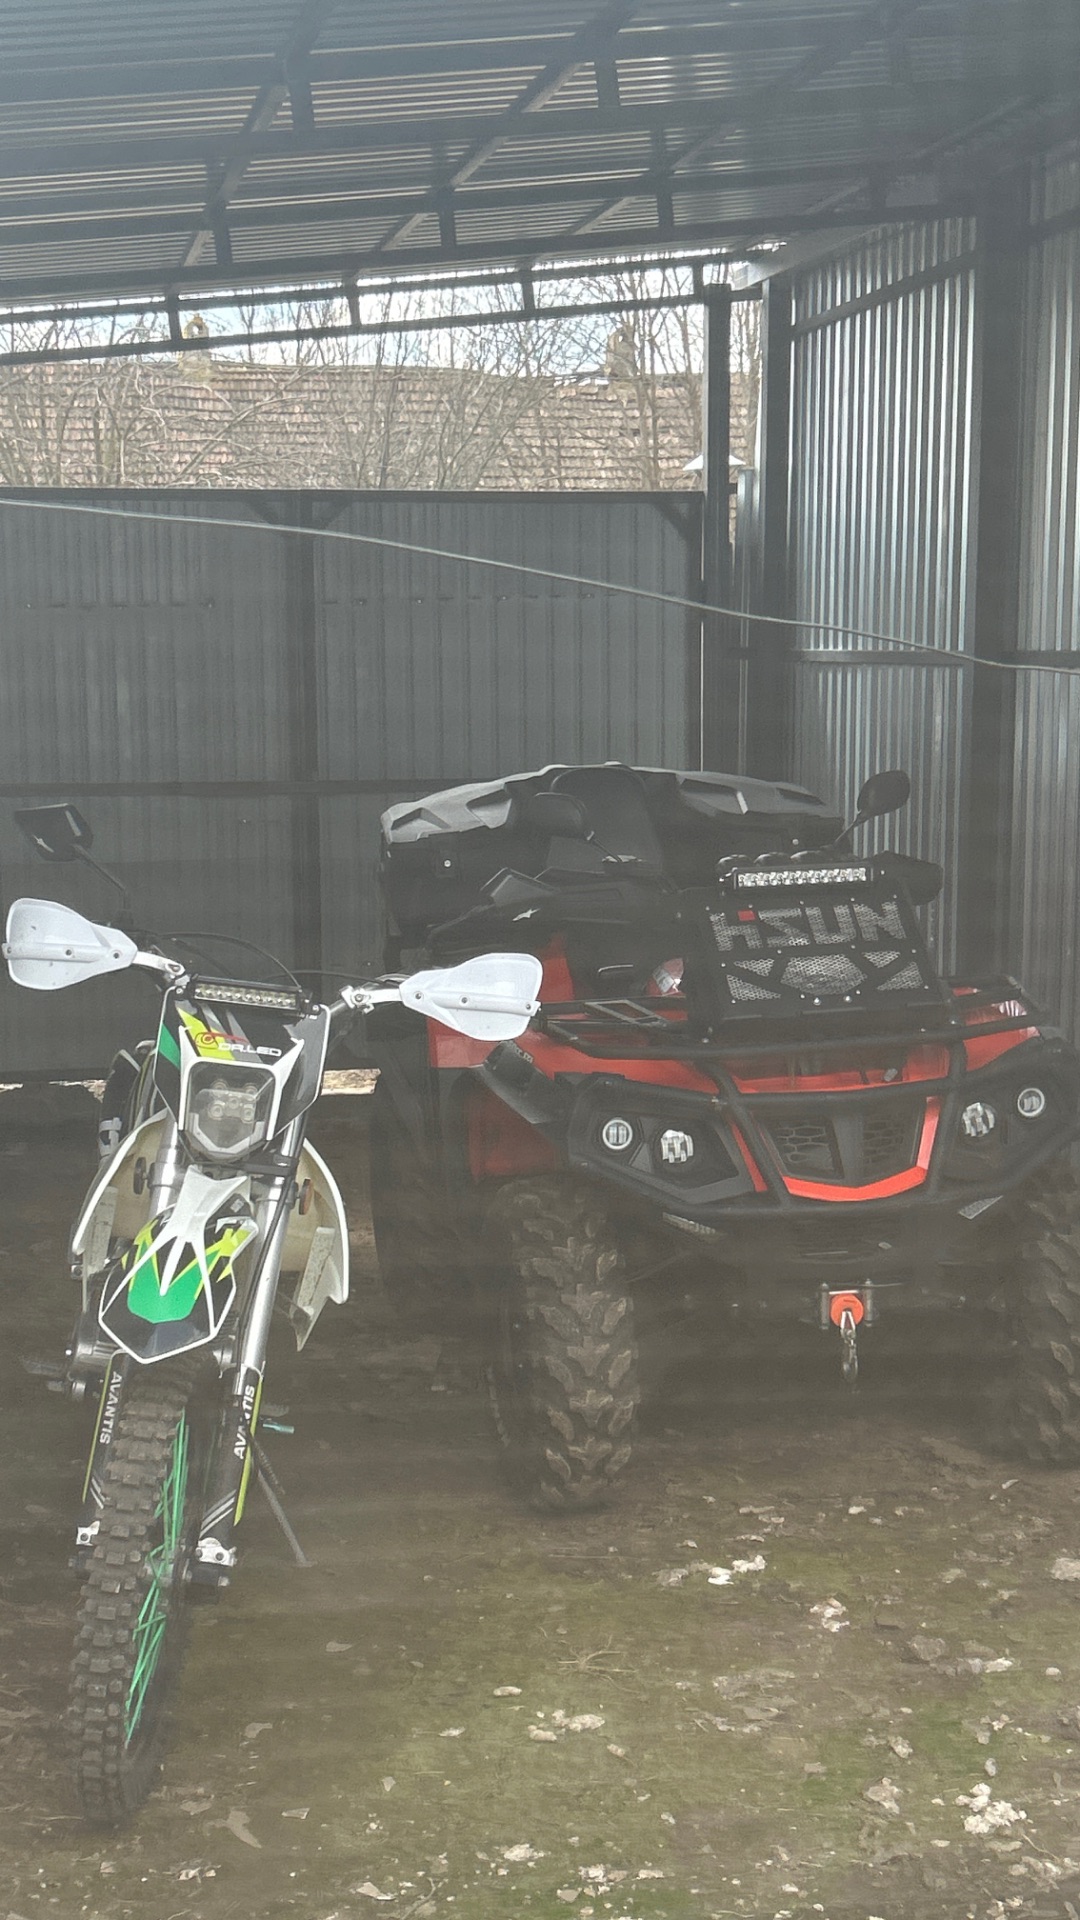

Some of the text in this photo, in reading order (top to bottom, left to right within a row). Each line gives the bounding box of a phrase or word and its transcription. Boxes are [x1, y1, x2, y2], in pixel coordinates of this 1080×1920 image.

[709, 901, 907, 951] HSUN
[219, 1042, 282, 1057] DR.LED
[99, 1371, 123, 1445] AVANTIS
